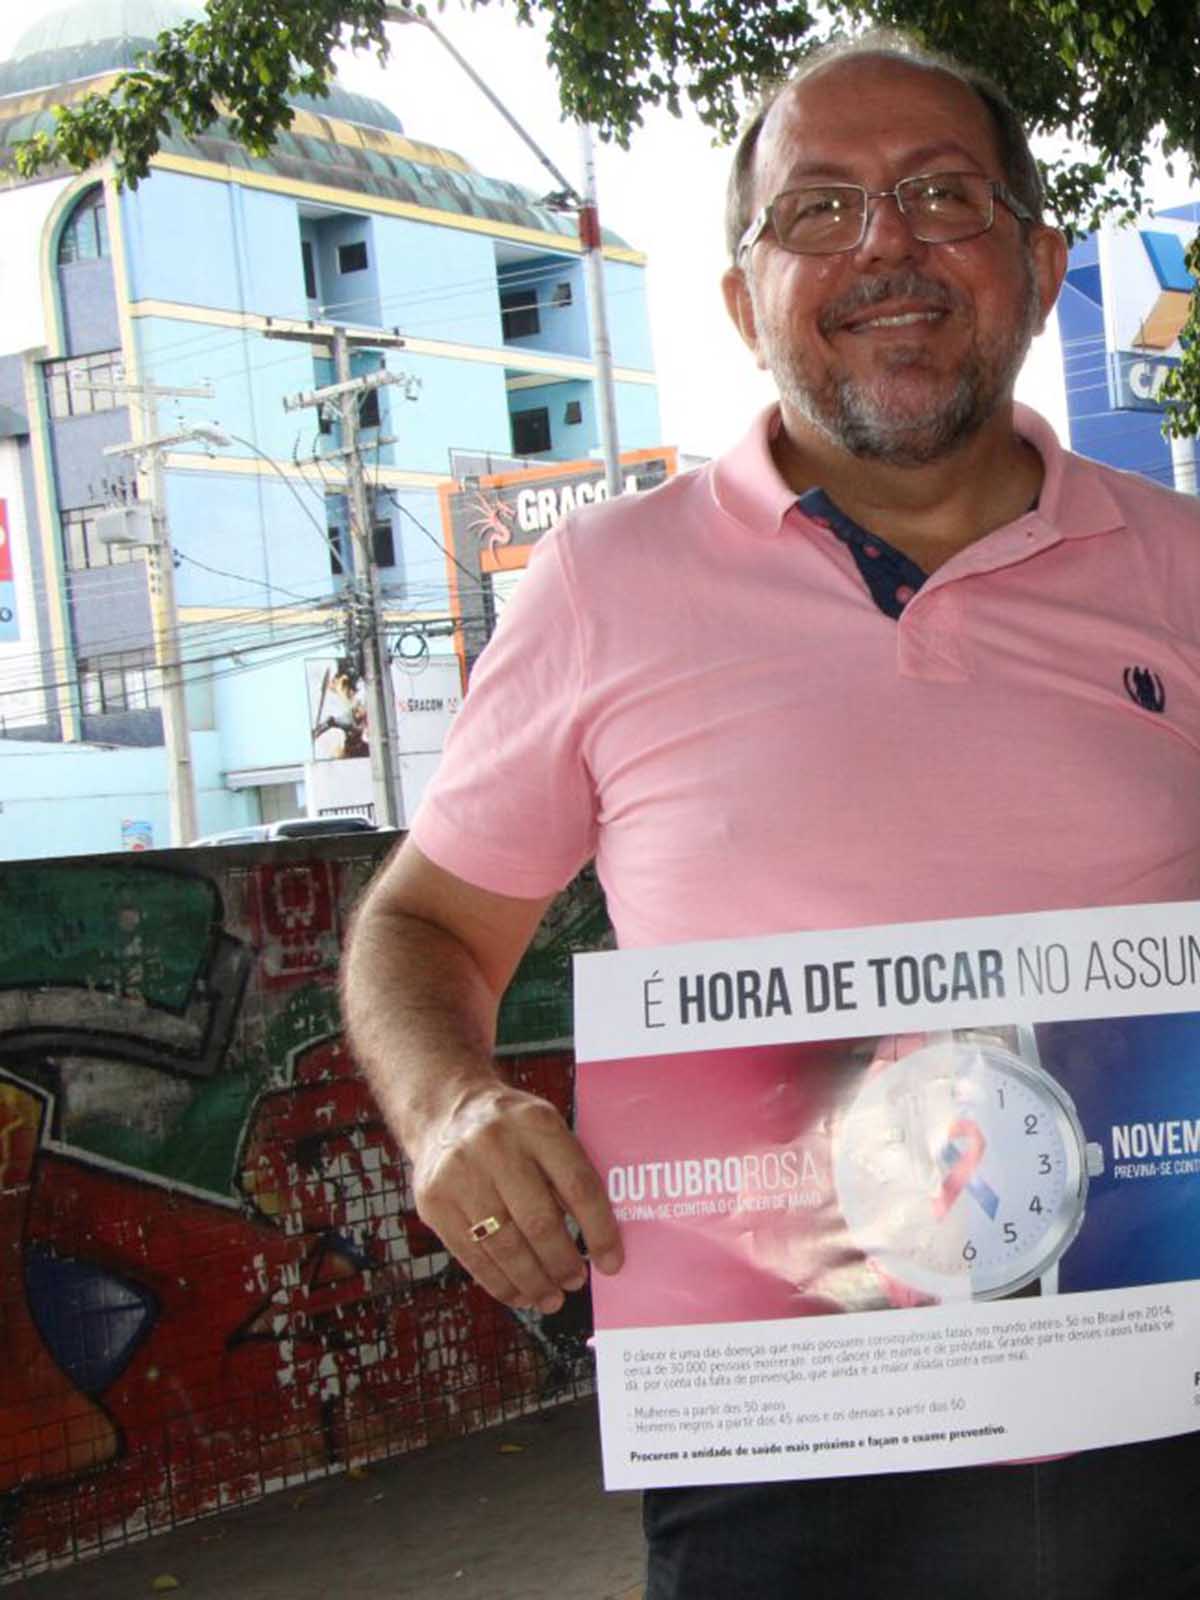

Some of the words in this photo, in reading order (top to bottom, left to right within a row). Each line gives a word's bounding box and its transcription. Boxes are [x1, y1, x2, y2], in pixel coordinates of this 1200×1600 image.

[644, 970, 665, 1028] É
[679, 967, 792, 1025] HORA
[805, 961, 857, 1014] DE
[868, 949, 1006, 1008] TOCAR
[1016, 944, 1070, 996] NO
[997, 1089, 1005, 1110] 1
[1024, 1114, 1038, 1135] 2
[1038, 1154, 1052, 1175] 3
[1114, 1163, 1173, 1179] PREVINA-SE
[1029, 1196, 1043, 1216] 4
[1003, 1222, 1017, 1244] 5
[962, 1240, 977, 1261] 6
[630, 1451, 680, 1463] Procurem
[692, 1446, 733, 1459] unidade
[735, 1446, 749, 1457] de
[752, 1442, 782, 1455] saúde
[785, 1441, 810, 1453] mais
[812, 1438, 855, 1455] próxima
[867, 1435, 899, 1449] façam
[911, 1431, 946, 1443] exame
